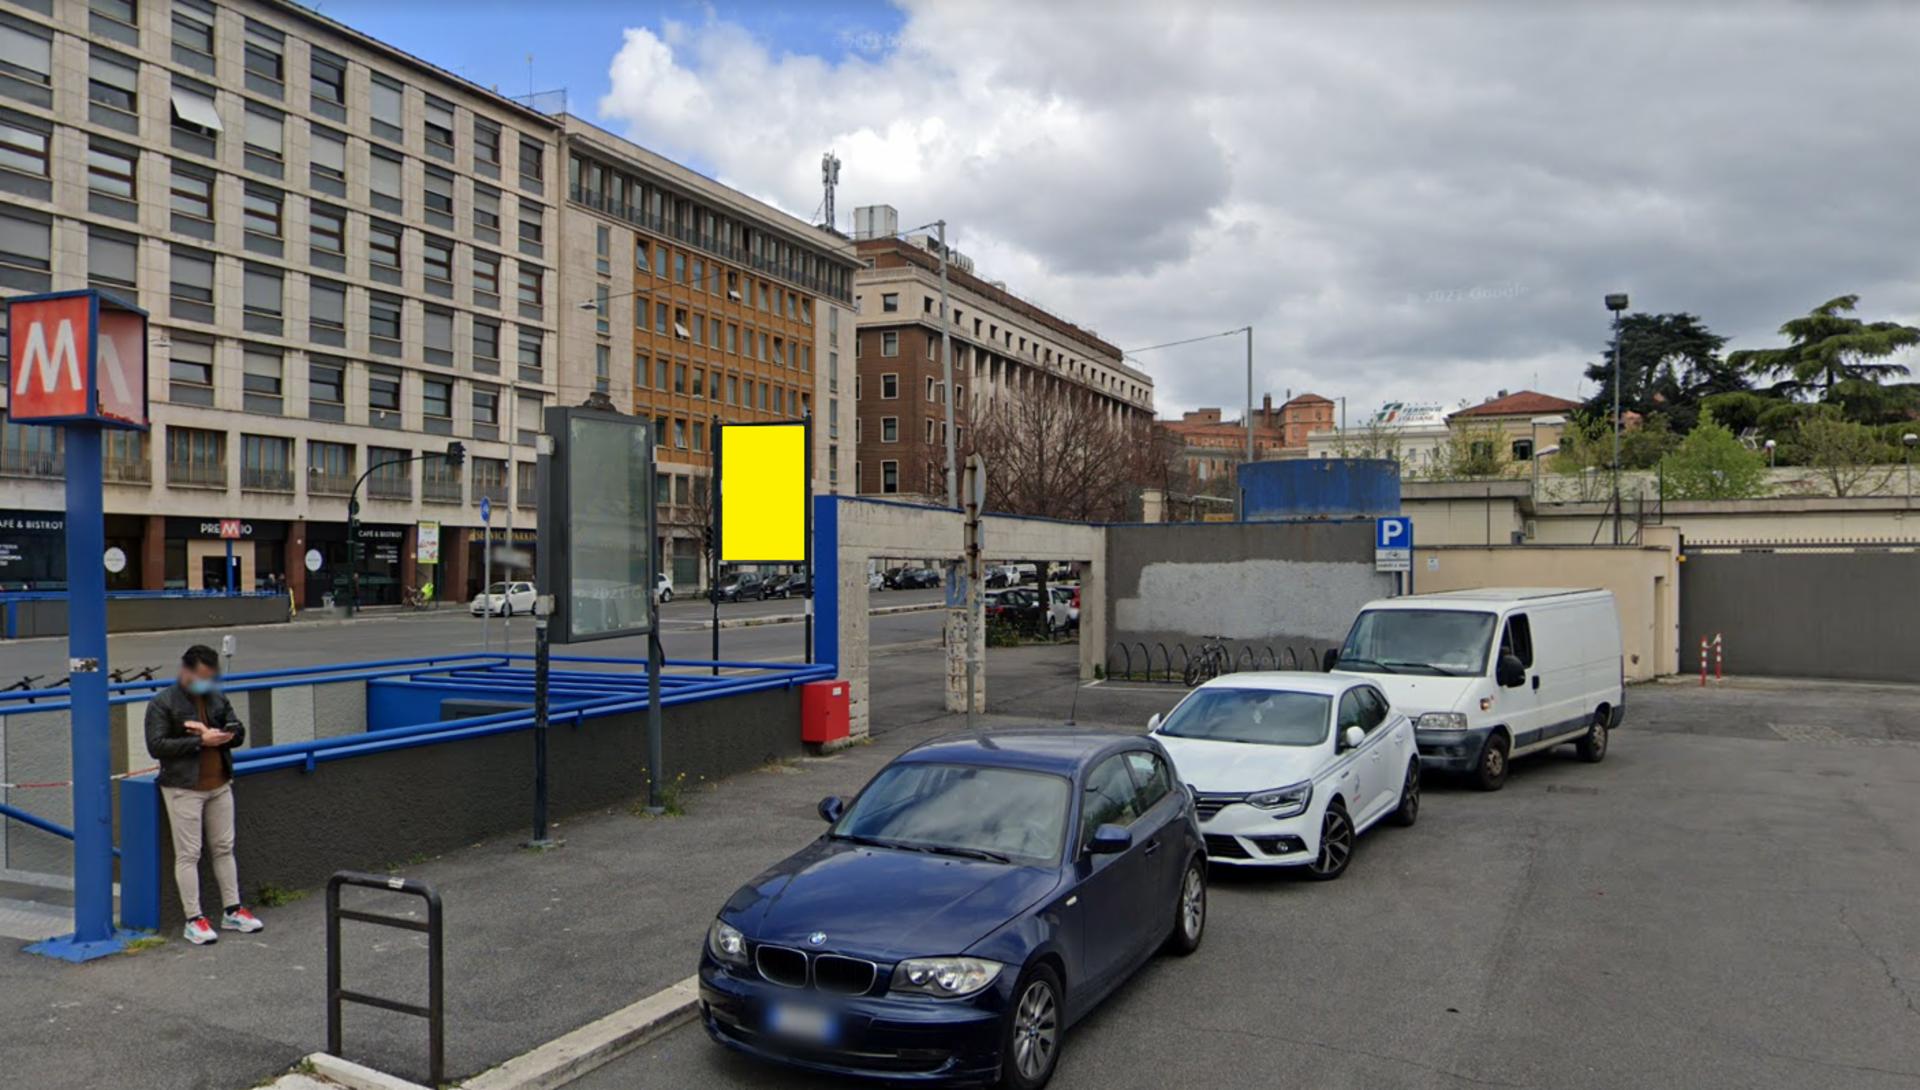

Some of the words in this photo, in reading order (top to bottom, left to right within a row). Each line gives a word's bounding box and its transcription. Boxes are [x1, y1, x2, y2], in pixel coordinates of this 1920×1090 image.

[16, 319, 82, 394] M
[16, 520, 24, 529] &
[25, 520, 64, 530] BISTROT
[221, 523, 239, 537] M
[1383, 520, 1403, 545] P
